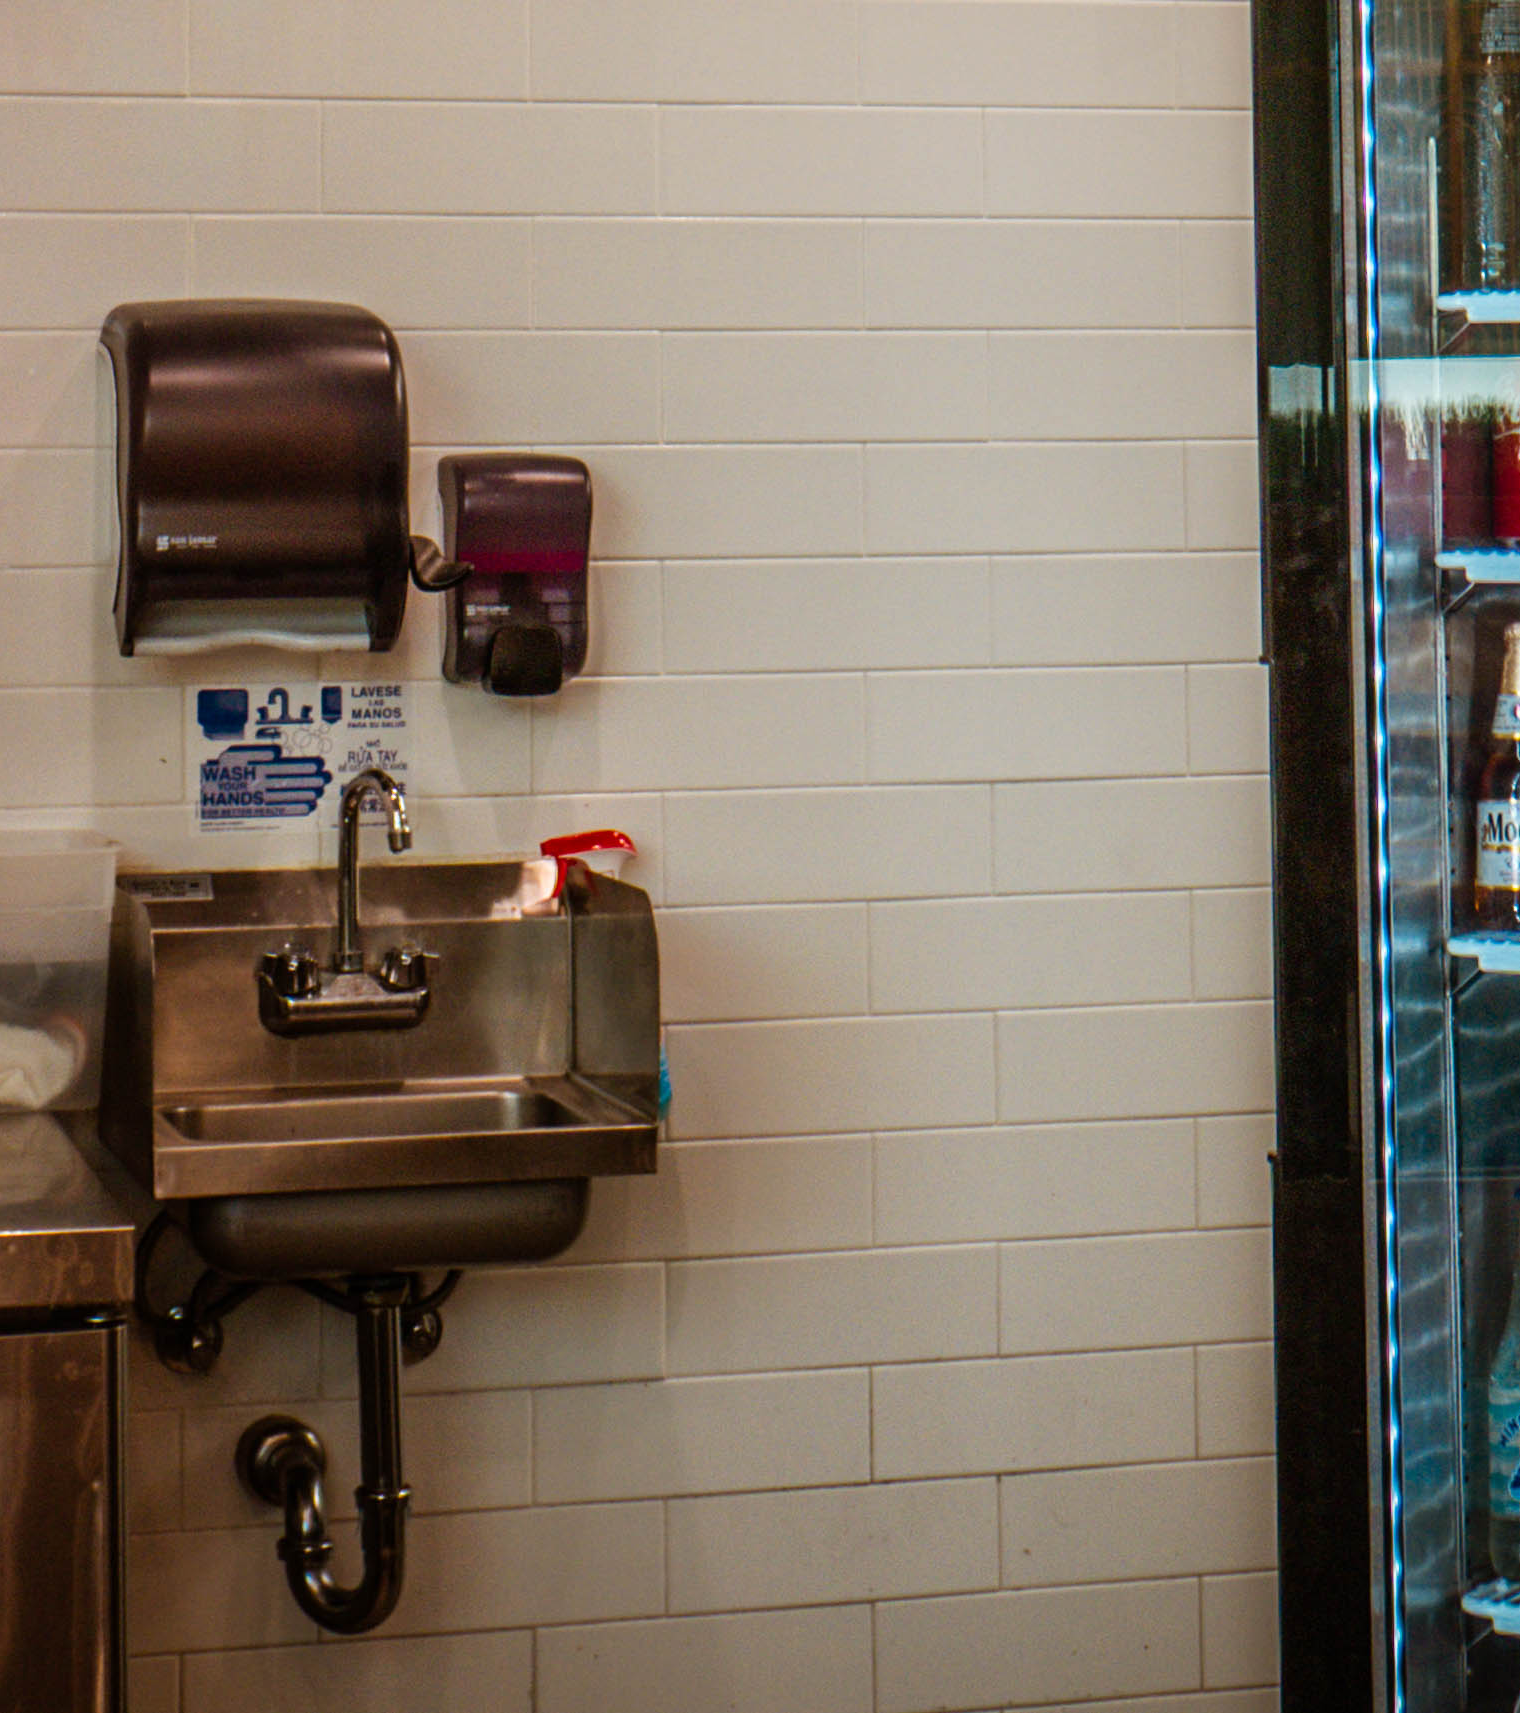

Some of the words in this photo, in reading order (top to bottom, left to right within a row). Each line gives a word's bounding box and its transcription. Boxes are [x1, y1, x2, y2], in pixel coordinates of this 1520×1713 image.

[351, 686, 402, 698] LAVESE
[351, 707, 402, 720] MANOS
[204, 767, 257, 781] WASH
[203, 791, 265, 806] HANDS
